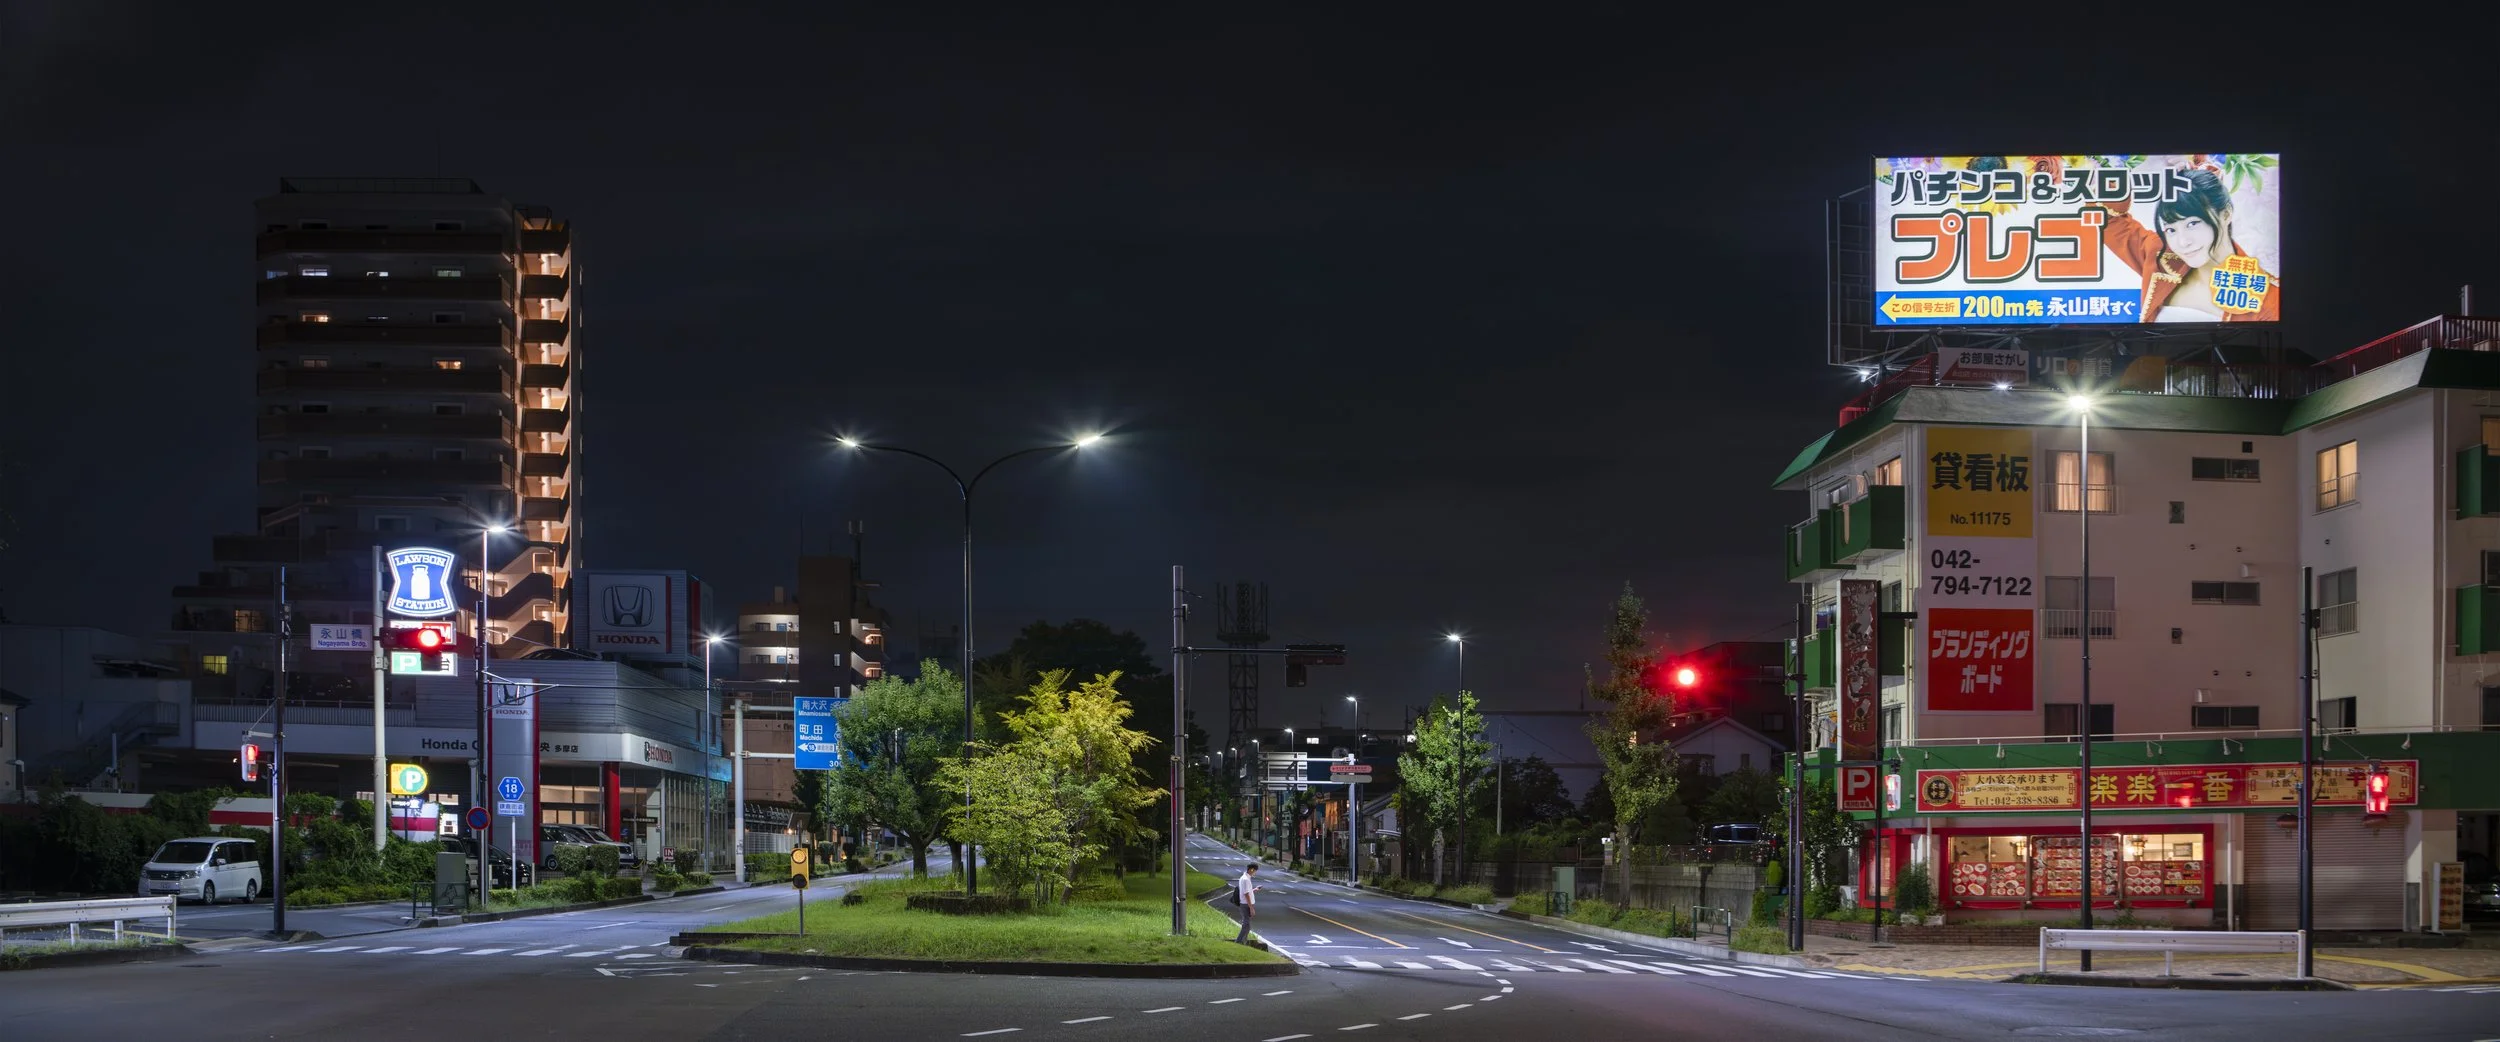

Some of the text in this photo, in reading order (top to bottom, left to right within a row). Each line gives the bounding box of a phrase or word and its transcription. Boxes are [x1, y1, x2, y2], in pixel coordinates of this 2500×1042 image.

[1891, 168, 2192, 205] パチンコ&スロット
[1892, 208, 2107, 283] プレゴ
[2228, 257, 2256, 274] 無料
[2212, 270, 2267, 293] 駐車場
[1891, 295, 2136, 317] この信号左折 200m先 永山駅すぐ
[1960, 351, 2026, 367] お部屋さがし
[1930, 451, 2029, 493] 貸看板
[1950, 511, 2011, 526] No.11175
[394, 554, 447, 567] LAWSON
[1930, 549, 1981, 569] 042-
[1930, 575, 2033, 597] 794-7122
[395, 598, 447, 611] STATION
[320, 627, 363, 640] 永山橋
[596, 634, 661, 645] HONDA
[317, 640, 350, 648] Nagayama
[1931, 628, 2031, 660] ブランディング
[400, 655, 417, 672] P
[1960, 664, 2004, 695] ボード
[802, 700, 827, 710] 南大沢
[799, 724, 823, 735] 町田
[422, 738, 468, 750] Honda
[555, 744, 579, 753] 多摩店
[648, 744, 673, 764] HONDA
[405, 770, 422, 790] P
[1847, 769, 1871, 796] P
[1975, 774, 2059, 784] 大小宴会承ります
[2090, 771, 2234, 804] 楽楽一番
[505, 784, 518, 793] 18
[1974, 796, 2060, 806] Tel:042-338-8386
[664, 848, 674, 857] IN
